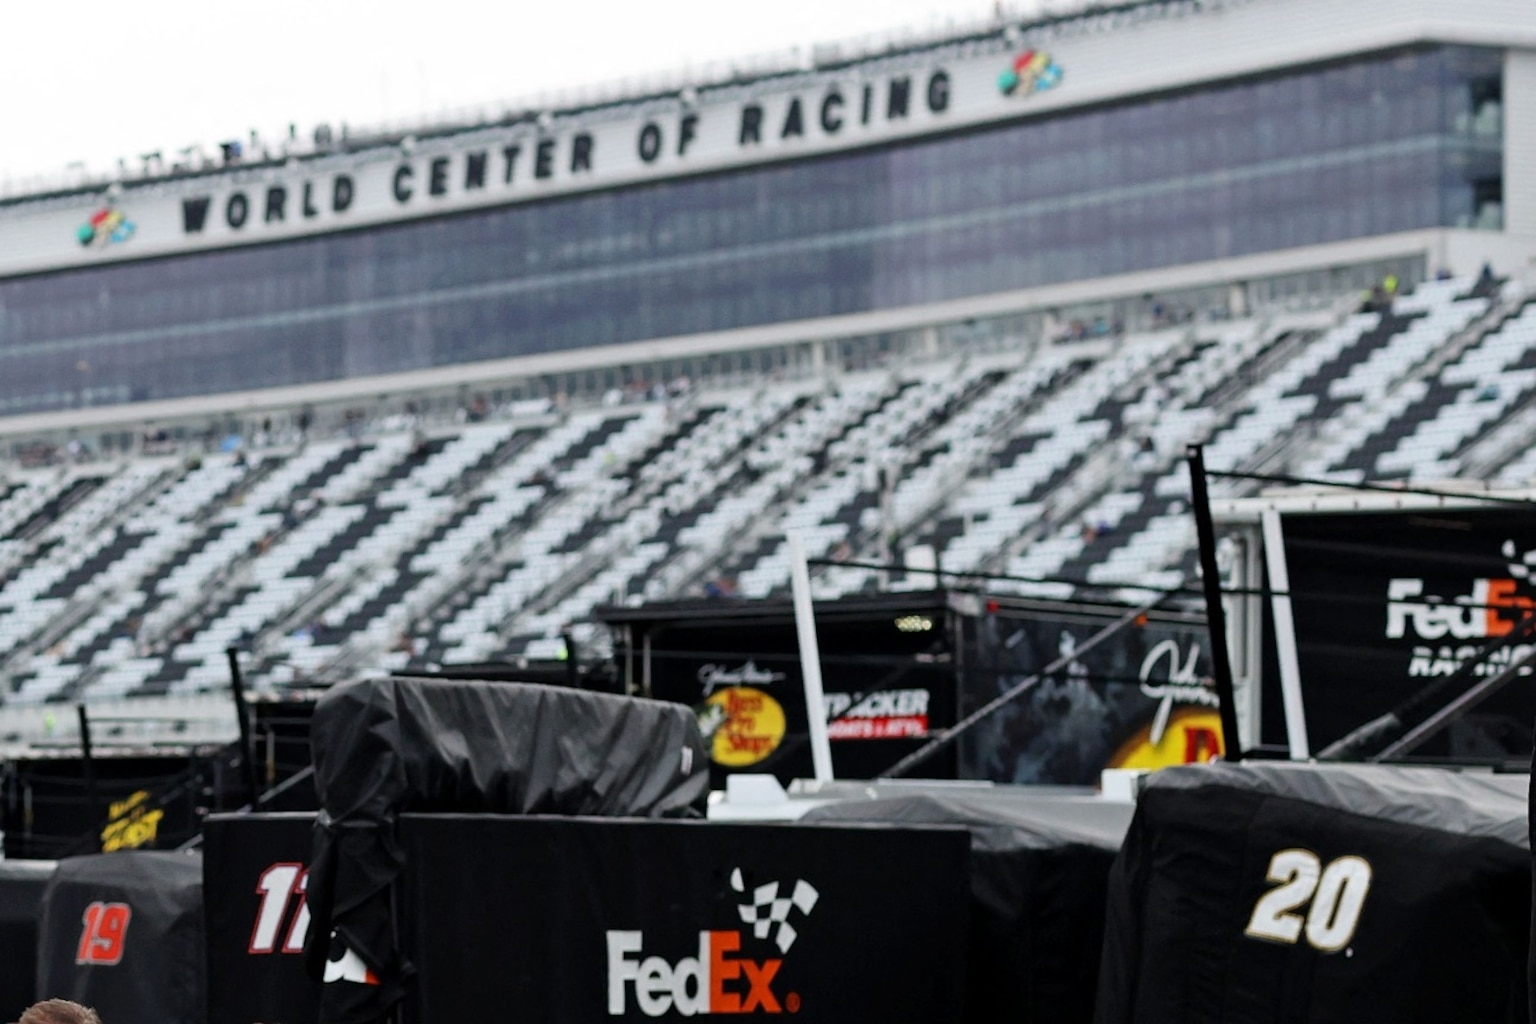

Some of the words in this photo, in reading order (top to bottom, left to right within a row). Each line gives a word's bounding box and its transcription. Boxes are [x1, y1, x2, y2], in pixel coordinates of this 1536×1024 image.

[182, 174, 356, 233] WORLD
[393, 132, 594, 204] CENTER
[637, 113, 700, 163] OF
[738, 70, 953, 146] RACING
[75, 900, 132, 966] 19
[1244, 847, 1373, 953] 20
[605, 929, 784, 1017] FedEx
